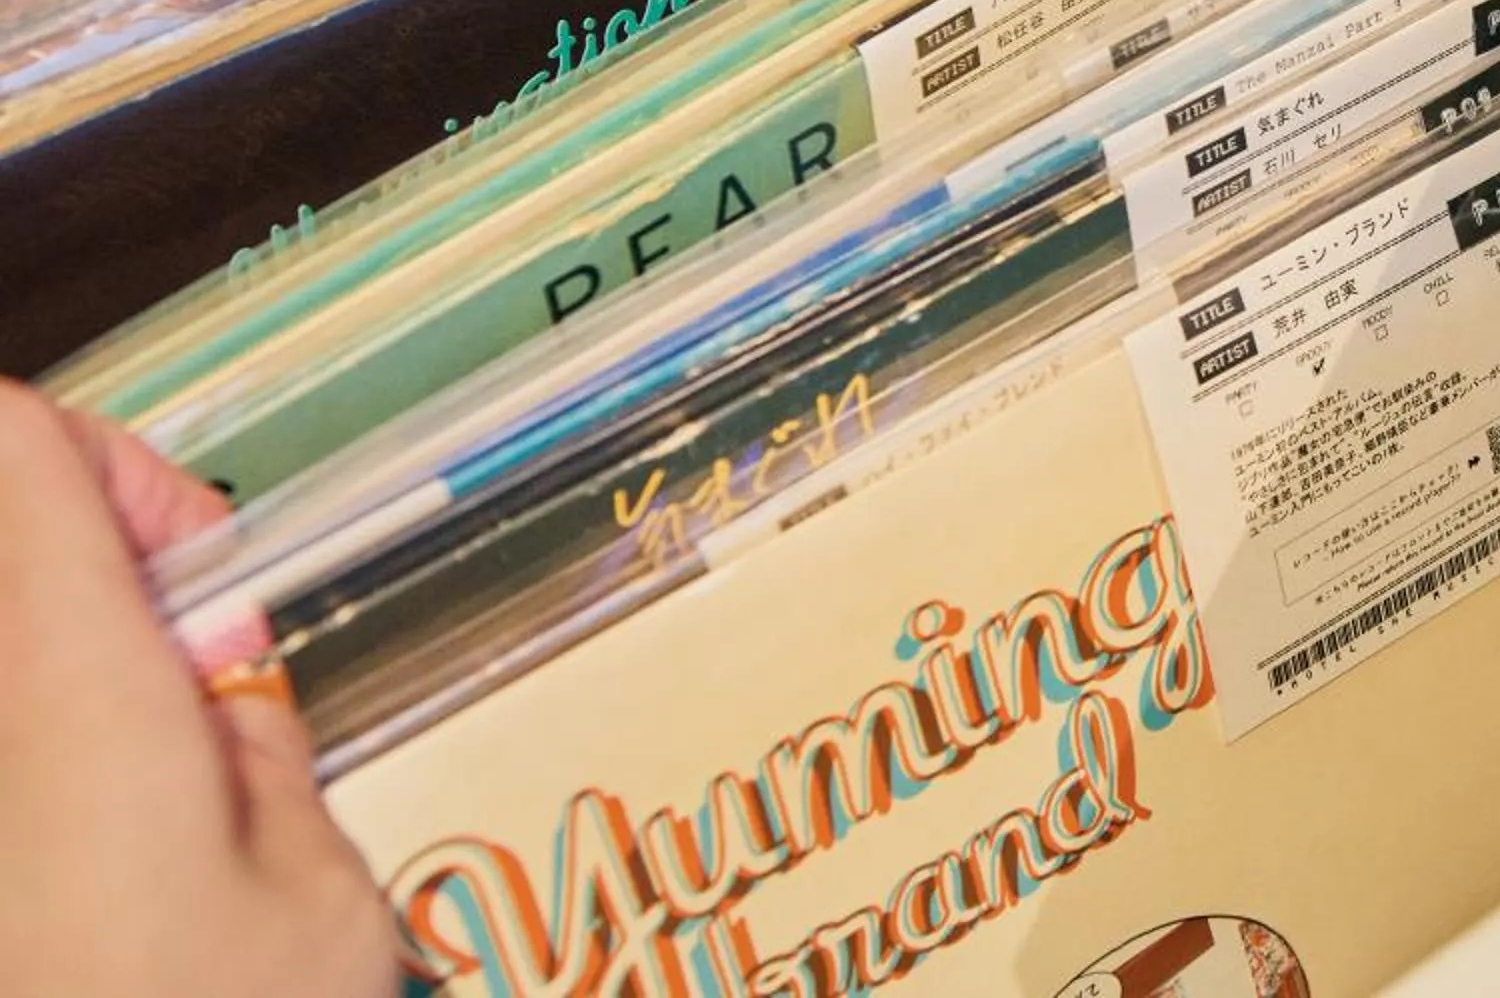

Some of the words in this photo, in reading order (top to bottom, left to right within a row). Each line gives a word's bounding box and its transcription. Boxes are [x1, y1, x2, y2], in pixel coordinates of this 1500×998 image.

[920, 16, 970, 50] TITLE
[921, 52, 980, 90] ARTIST
[1172, 94, 1220, 127] TITLE
[1194, 136, 1239, 167] TITLE
[1252, 88, 1326, 137] 気まぐれ
[1193, 174, 1250, 211] ARTIST
[1259, 147, 1298, 176] 石川
[1309, 122, 1345, 151] セリ
[1187, 296, 1236, 329] TITLE
[1257, 196, 1415, 292] ユーミン・ブランド
[1195, 338, 1255, 378] ARTIST
[1269, 307, 1310, 338] 荒井
[1319, 277, 1362, 310] 由実
